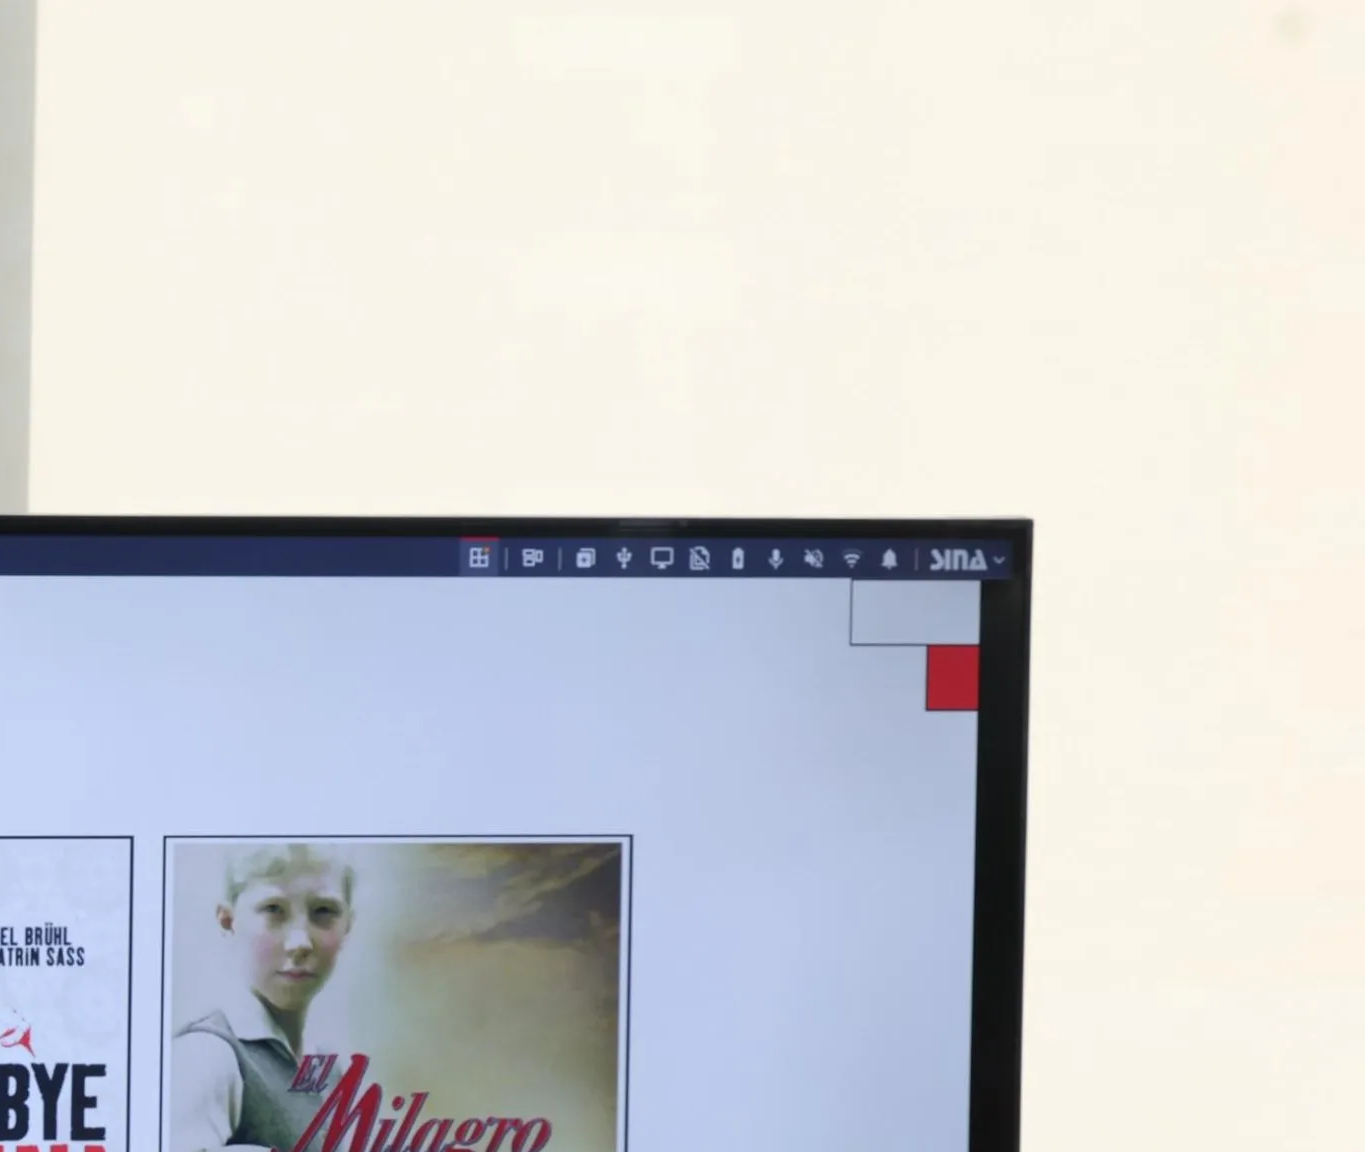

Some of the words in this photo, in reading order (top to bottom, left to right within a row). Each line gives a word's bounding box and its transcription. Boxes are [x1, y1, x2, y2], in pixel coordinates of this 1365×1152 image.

[25, 922, 71, 947] BRÜHL
[47, 948, 85, 966] SASS
[288, 1053, 338, 1093] El
